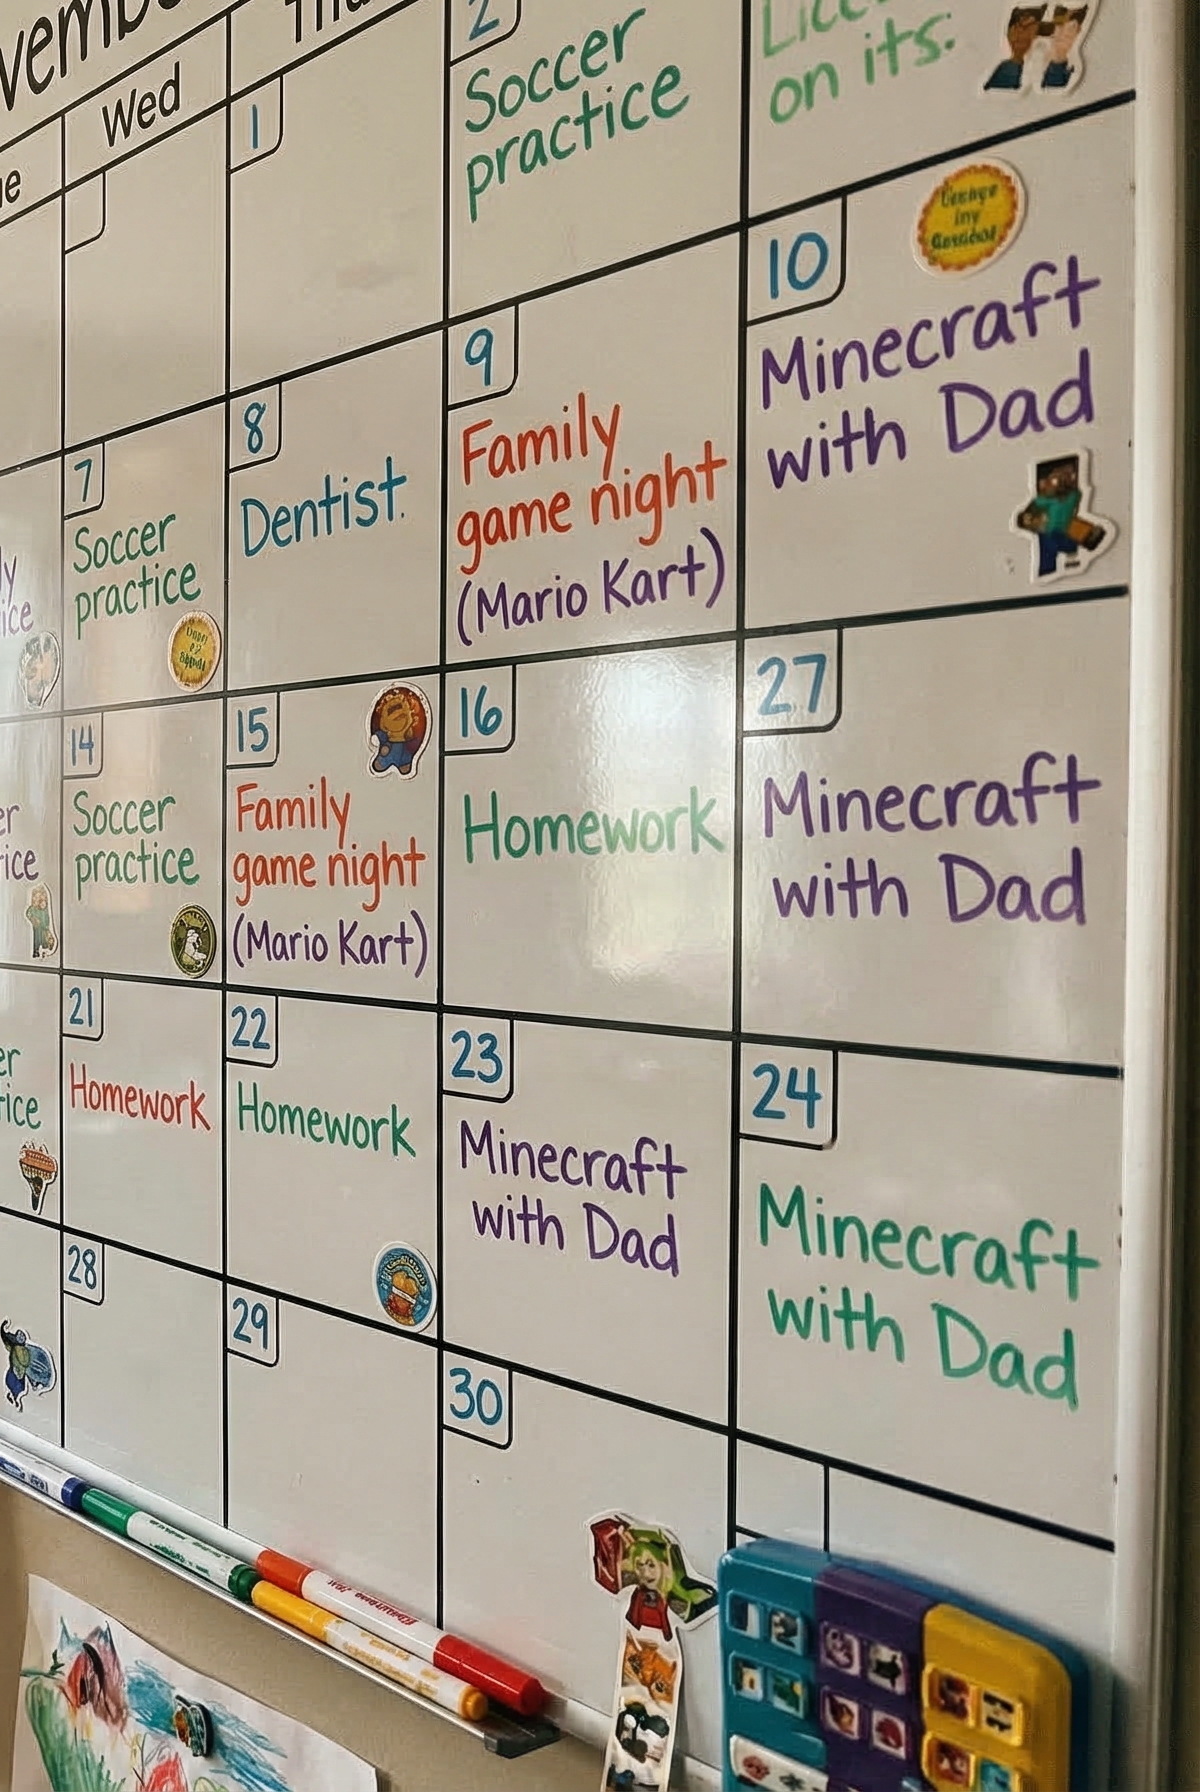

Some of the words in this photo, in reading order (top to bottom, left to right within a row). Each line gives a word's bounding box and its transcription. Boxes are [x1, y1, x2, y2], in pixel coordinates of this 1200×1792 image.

[465, 8, 647, 132] Soccer
[770, 62, 839, 123] on
[102, 61, 181, 148] Wed
[251, 104, 259, 149] 1
[467, 65, 690, 223] practice
[769, 232, 829, 300] 10
[465, 328, 494, 386] 9
[762, 255, 1101, 410] Minecraft
[243, 402, 267, 454] 8
[463, 392, 621, 486] Family
[767, 407, 907, 489] with
[938, 348, 1095, 453] Dad
[74, 459, 92, 502] 7
[457, 491, 572, 576] game
[591, 440, 728, 547] night
[73, 513, 176, 574] Soccer
[75, 562, 201, 640] practice
[457, 574, 589, 646] (Mario
[603, 527, 725, 614] Kart)
[461, 685, 502, 737] 16
[756, 653, 827, 716] 27
[71, 724, 94, 767] 14
[237, 706, 268, 752] 15
[73, 790, 176, 837] Soccer
[236, 776, 351, 849] Family
[464, 785, 726, 864] Homework
[763, 750, 1103, 838] Minecraft
[75, 838, 200, 901] practice
[233, 852, 317, 907] game
[328, 836, 427, 913] night
[772, 856, 909, 919] with
[938, 846, 1087, 926] Dad
[233, 911, 329, 969] (Mario
[338, 910, 428, 978] Kart)
[69, 987, 93, 1028] 21
[230, 1005, 270, 1050] 22
[451, 1030, 503, 1083] 23
[70, 1062, 211, 1131] Homework
[238, 1081, 416, 1157] Homework
[752, 1063, 822, 1129] 24
[460, 1120, 688, 1200] Minecraft
[67, 1244, 97, 1290] 28
[472, 1194, 565, 1250] with
[582, 1202, 679, 1278] Dad
[760, 1182, 1101, 1302] Minecraft
[232, 1298, 268, 1350] 29
[767, 1285, 905, 1364] with
[930, 1302, 1079, 1412] Dad
[448, 1367, 503, 1427] 30
